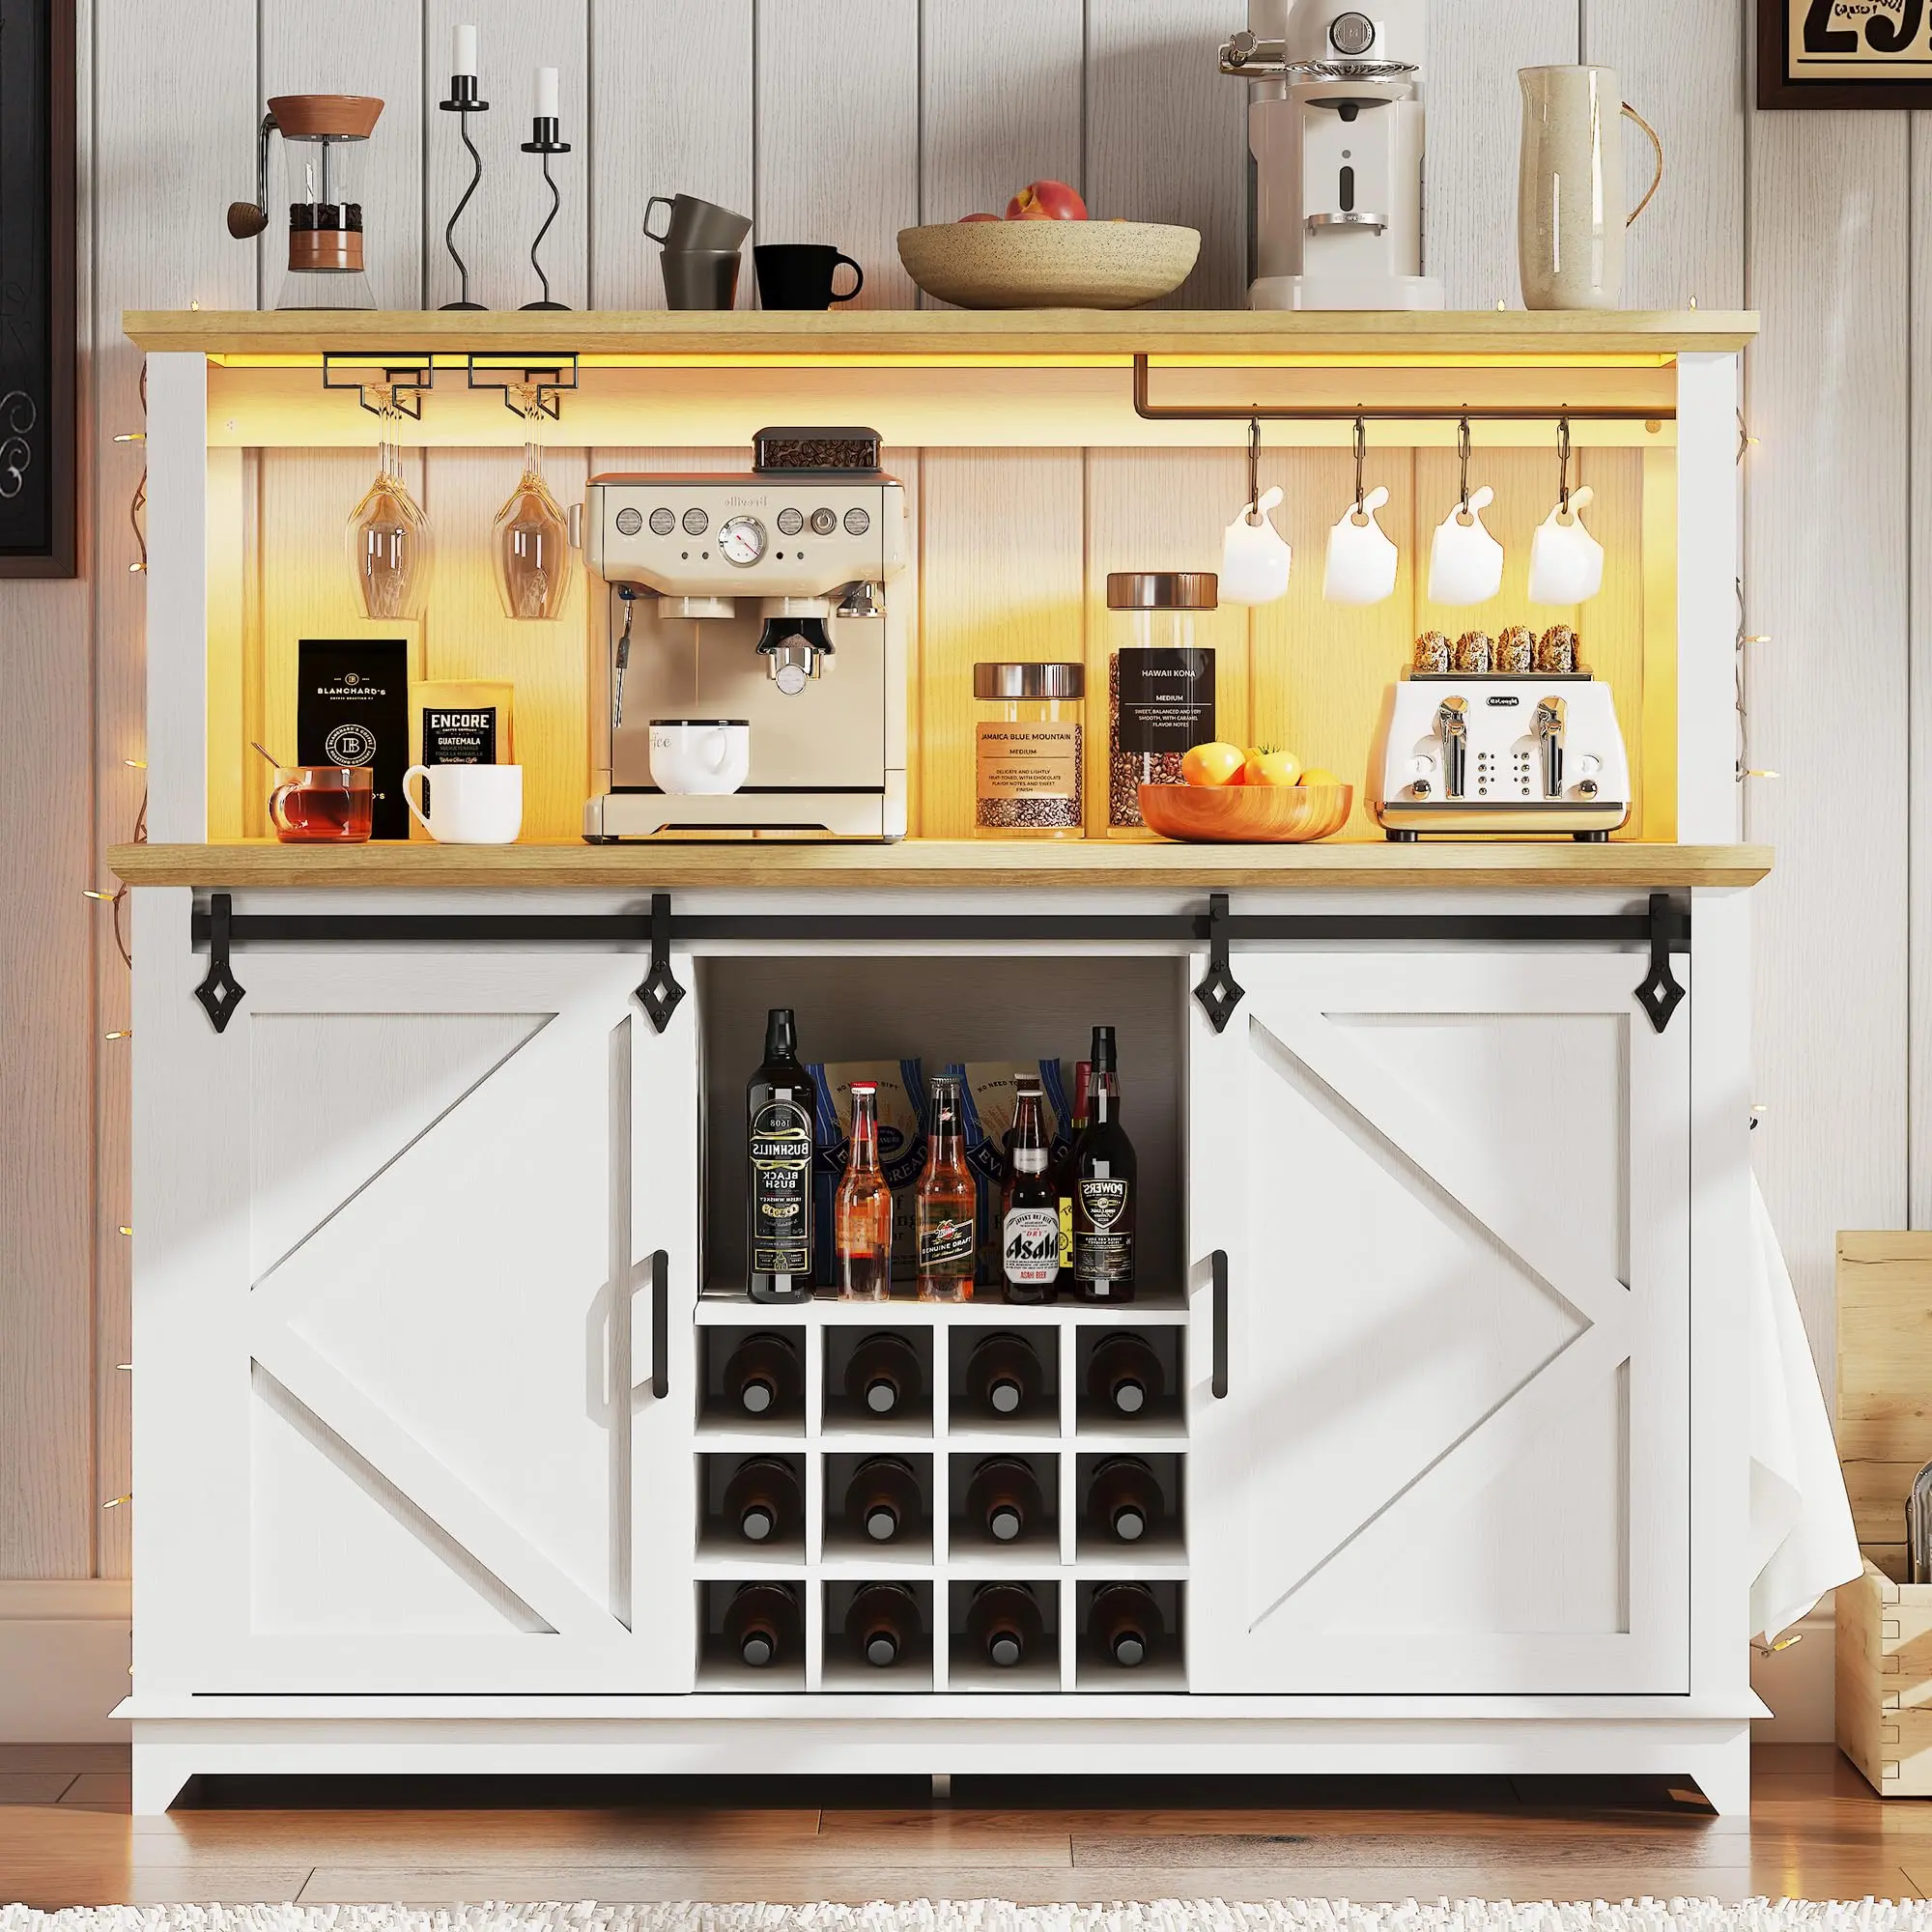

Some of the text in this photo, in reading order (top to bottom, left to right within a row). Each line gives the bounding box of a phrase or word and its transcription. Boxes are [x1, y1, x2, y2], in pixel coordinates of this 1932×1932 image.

[317, 687, 386, 696] BLANCHARD'S
[431, 714, 490, 729] ENCORE
[438, 737, 481, 746] GUATEMALA
[978, 1084, 987, 1094] NO
[988, 1080, 1008, 1089] NEED
[888, 1145, 927, 1182] READ
[922, 1242, 951, 1255] GENUINE
[952, 1236, 972, 1247] DRAFT
[1006, 1232, 1058, 1260] Asahi
